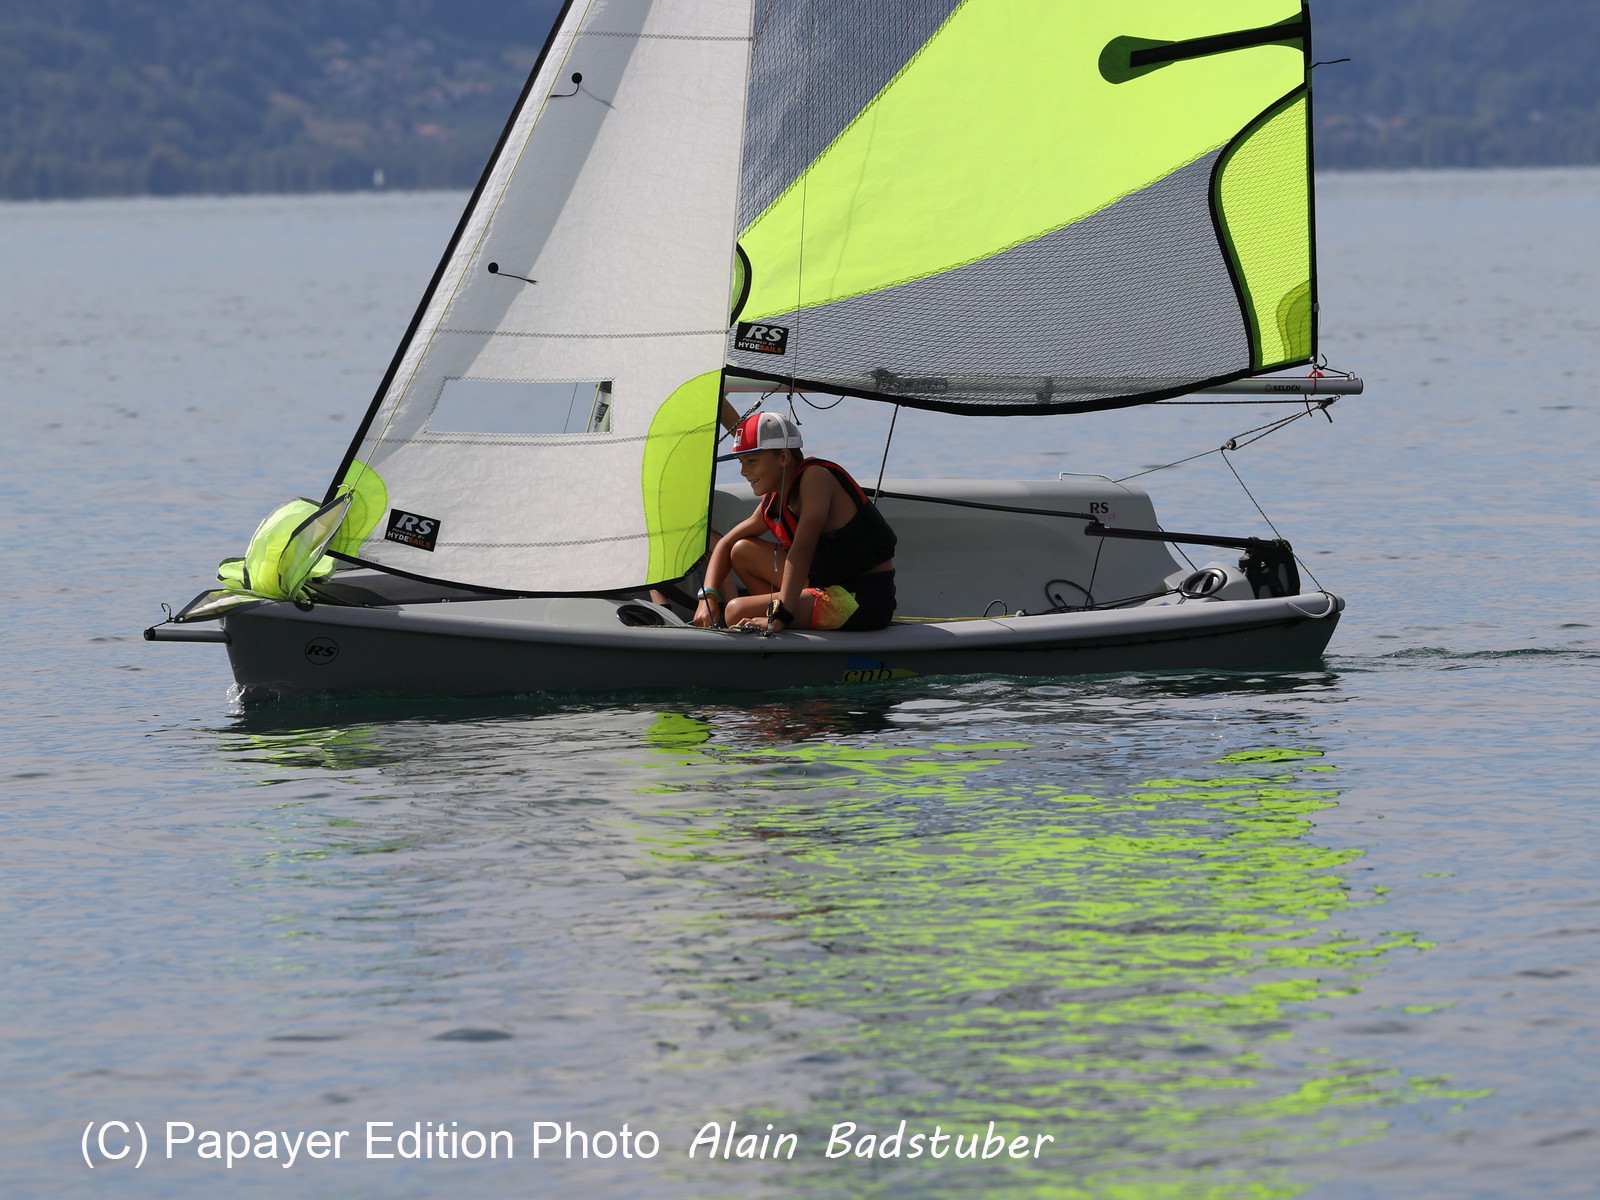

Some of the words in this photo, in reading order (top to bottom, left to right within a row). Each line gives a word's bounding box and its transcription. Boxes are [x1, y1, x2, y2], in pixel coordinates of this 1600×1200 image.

[745, 325, 784, 342] RS
[1090, 501, 1109, 514] RS
[395, 513, 435, 535] RS
[307, 645, 337, 657] RS
